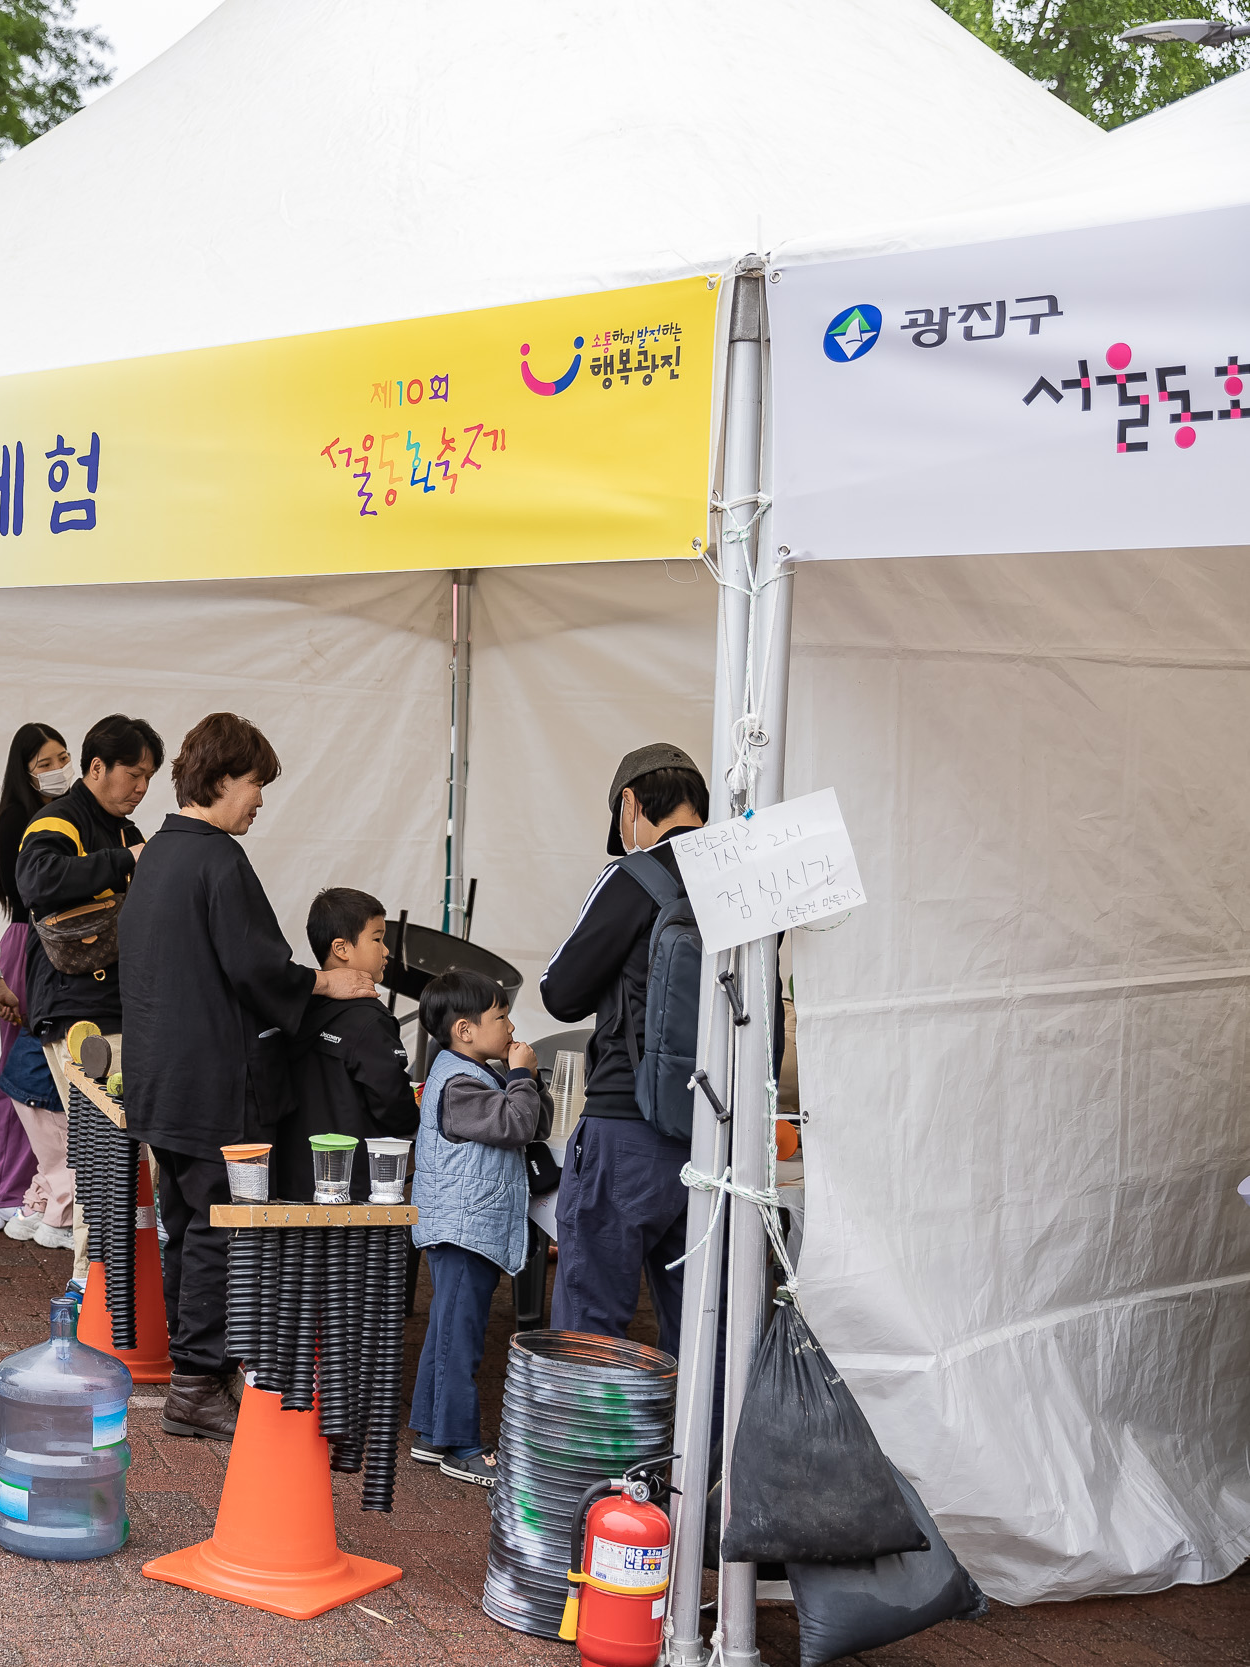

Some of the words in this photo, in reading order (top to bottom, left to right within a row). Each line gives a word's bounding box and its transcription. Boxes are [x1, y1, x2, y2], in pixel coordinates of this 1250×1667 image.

[591, 328, 634, 354] 소통하며
[637, 322, 682, 349] 발전하는
[900, 294, 1064, 349] 광진구
[590, 345, 681, 390] 행복광진
[370, 373, 450, 409] 제10회
[320, 423, 506, 517] 서울동화축제
